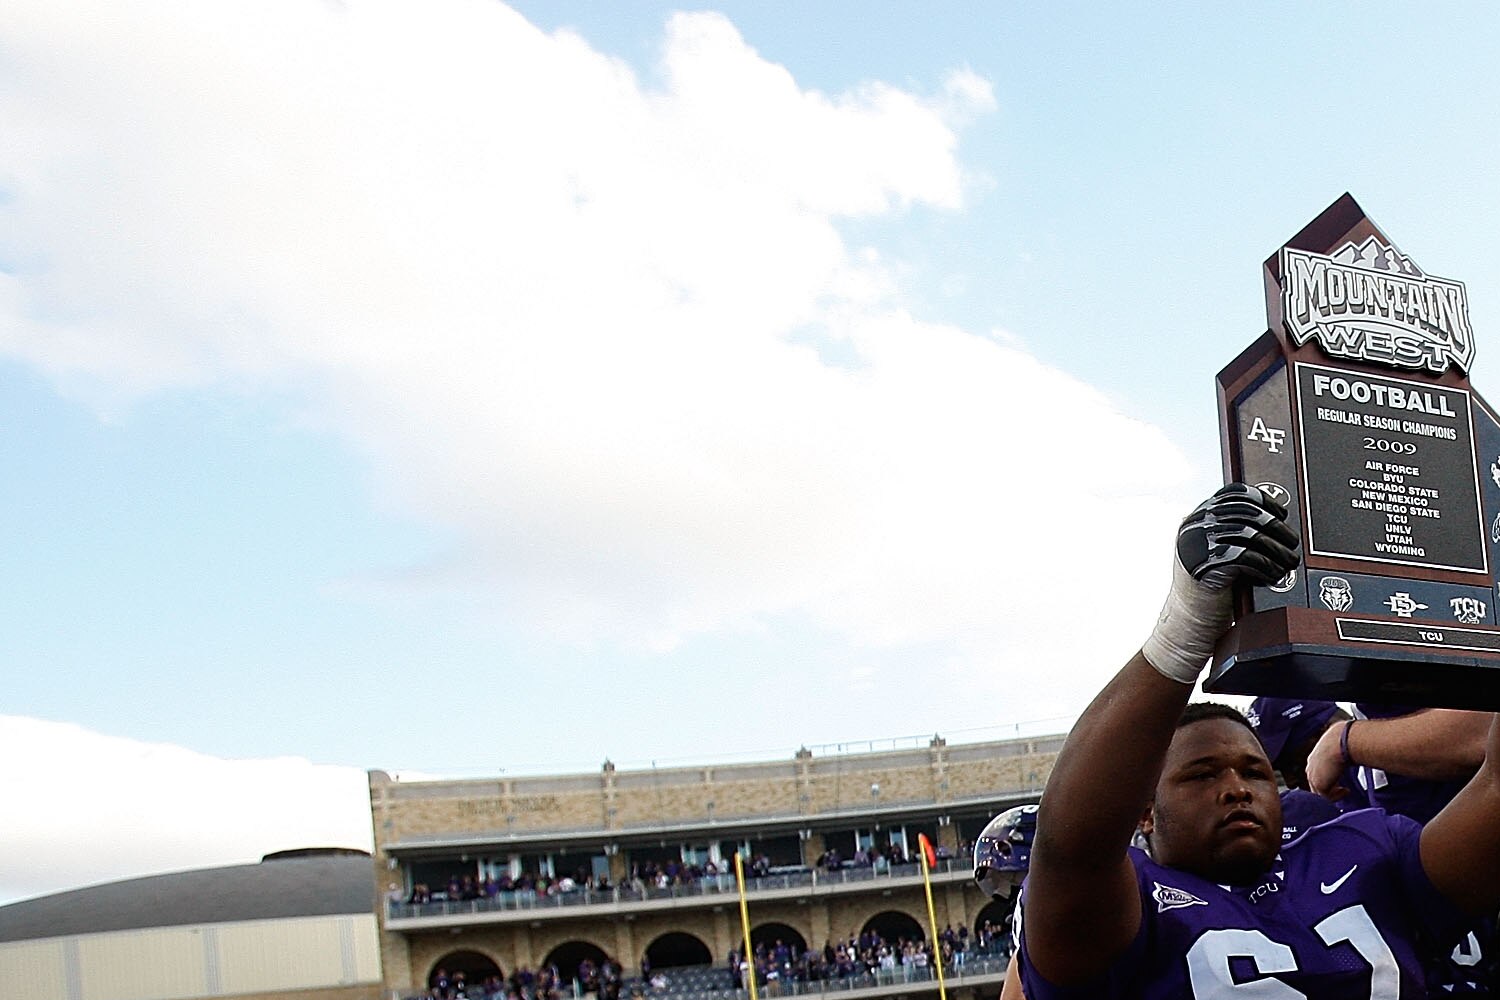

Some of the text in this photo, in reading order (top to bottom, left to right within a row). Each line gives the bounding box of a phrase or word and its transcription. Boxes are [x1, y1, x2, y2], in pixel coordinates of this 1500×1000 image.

[1294, 256, 1466, 351] MOUNTAIN
[1316, 322, 1451, 369] WEST
[1313, 374, 1456, 417] FOOTBALL
[1317, 407, 1457, 440] REGULAR SEASON CHAMPIONS
[1363, 437, 1417, 455] 2009
[1365, 460, 1420, 476] AIR FORCE
[1383, 473, 1404, 483] BYU
[1349, 478, 1439, 499] COLORADO STATE
[1362, 490, 1429, 507] NEW MEXICO
[1351, 499, 1441, 519] SAN DIEGO STATE
[1386, 513, 1408, 524] TCU
[1385, 523, 1412, 535] UNLV
[1385, 533, 1413, 545] UTAH
[1374, 542, 1426, 557] WYOMING
[1418, 631, 1444, 642] TCU
[1248, 882, 1279, 904] TCU
